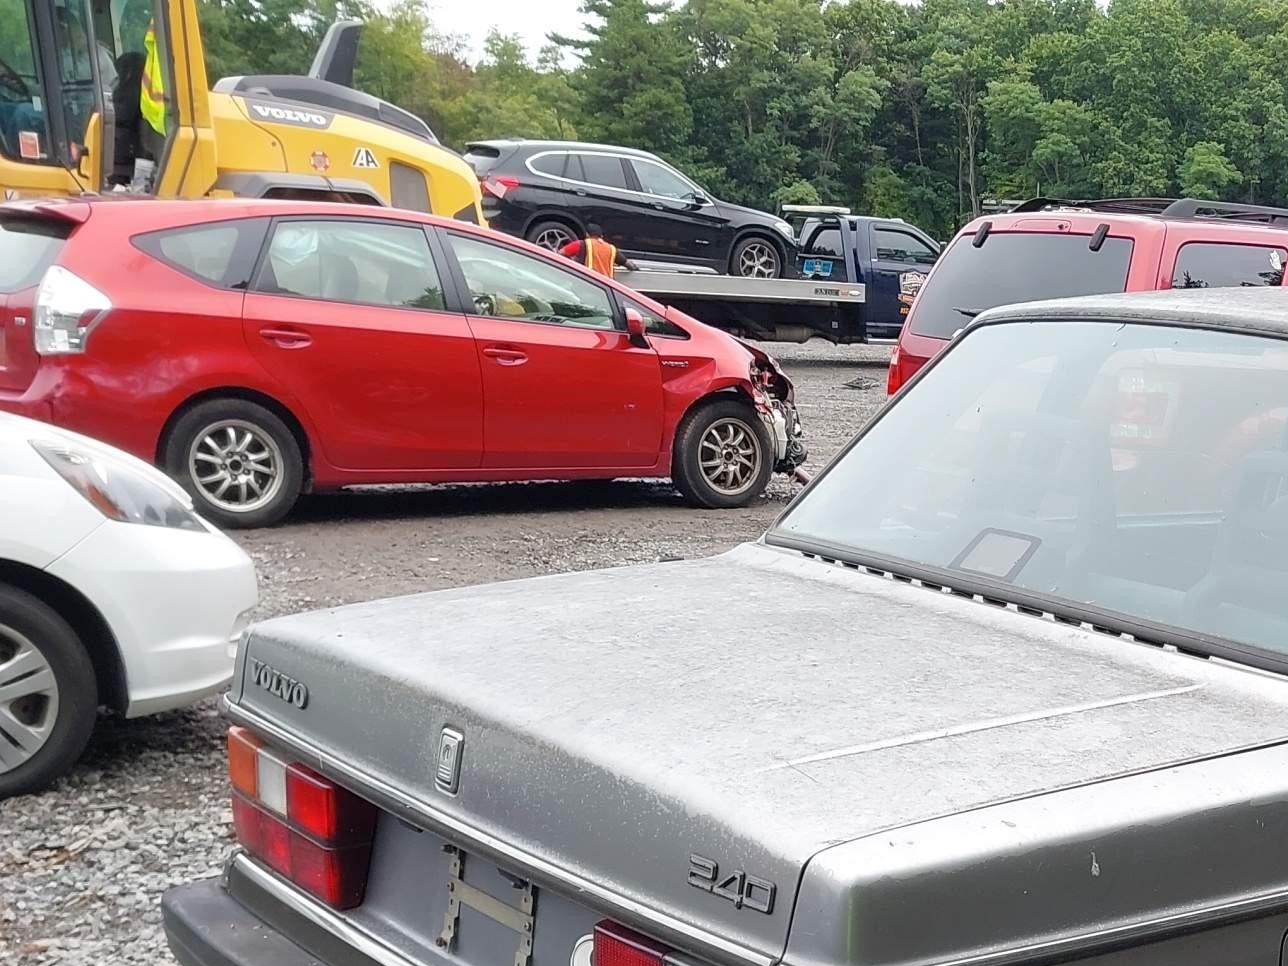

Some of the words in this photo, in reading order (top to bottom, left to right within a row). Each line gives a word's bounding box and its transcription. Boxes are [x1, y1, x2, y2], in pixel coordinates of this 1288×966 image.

[252, 105, 327, 125] VOLVO
[249, 656, 309, 710] VOLVO
[687, 853, 777, 915] 240
